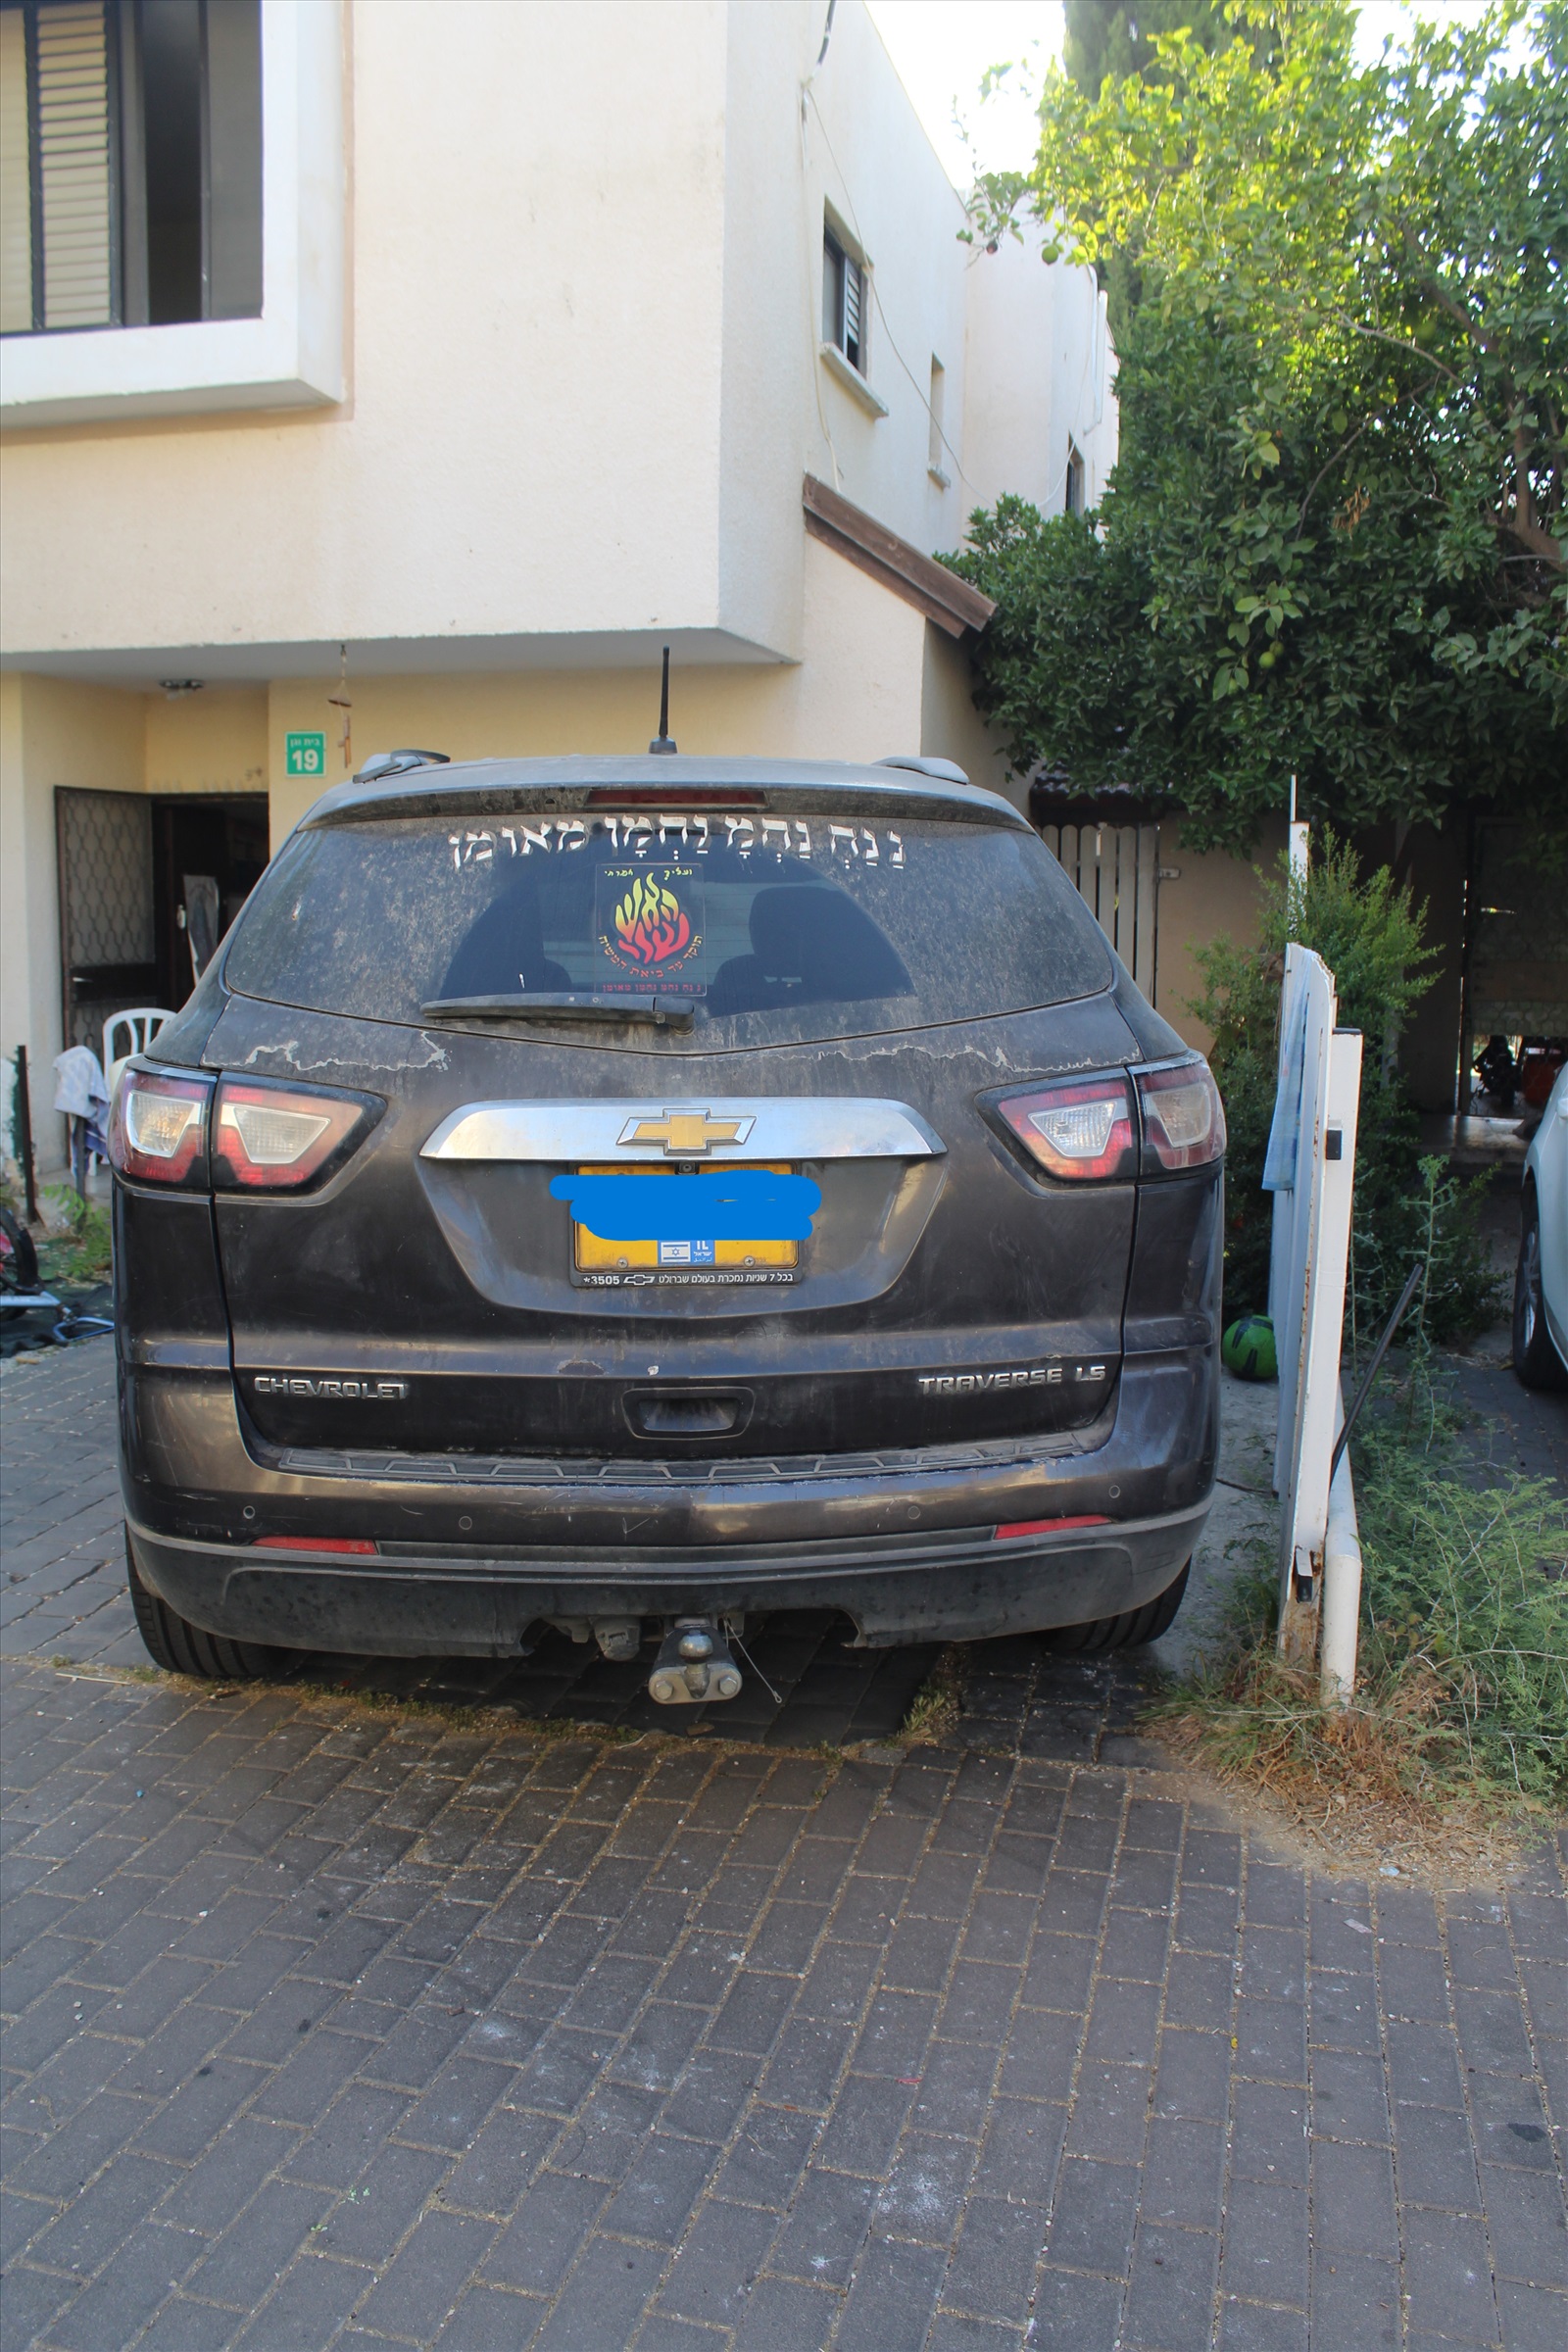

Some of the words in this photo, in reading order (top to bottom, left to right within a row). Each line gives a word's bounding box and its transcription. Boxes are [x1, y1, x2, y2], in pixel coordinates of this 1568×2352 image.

[292, 749, 318, 771] 19
[667, 961, 684, 972] עד
[629, 967, 664, 978] ביאת
[659, 1274, 689, 1284] שברולט
[691, 1273, 715, 1283] בעולם
[717, 1274, 743, 1283] נמכרת
[746, 1273, 767, 1282] שניות
[776, 1272, 793, 1282] בכל
[918, 1367, 1063, 1395] TRAVERSE
[1075, 1365, 1105, 1382] LS
[254, 1376, 407, 1399] CHEVROLET
